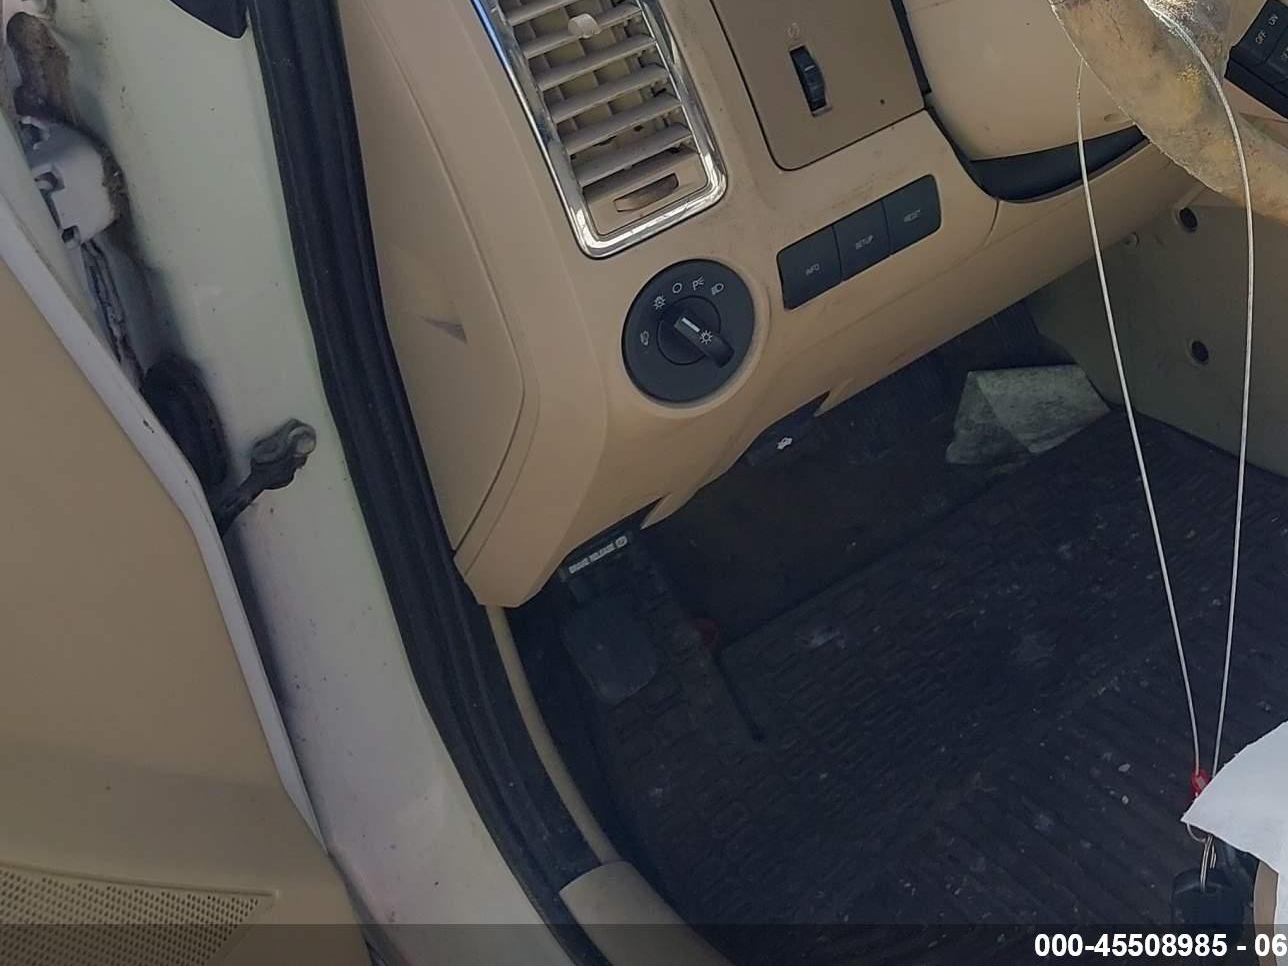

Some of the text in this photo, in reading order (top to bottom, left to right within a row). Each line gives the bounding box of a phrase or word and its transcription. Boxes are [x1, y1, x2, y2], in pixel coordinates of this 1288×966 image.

[1268, 15, 1279, 26] ON
[1255, 30, 1267, 44] OFF
[855, 234, 874, 250] SETUP
[805, 263, 820, 276] INFO
